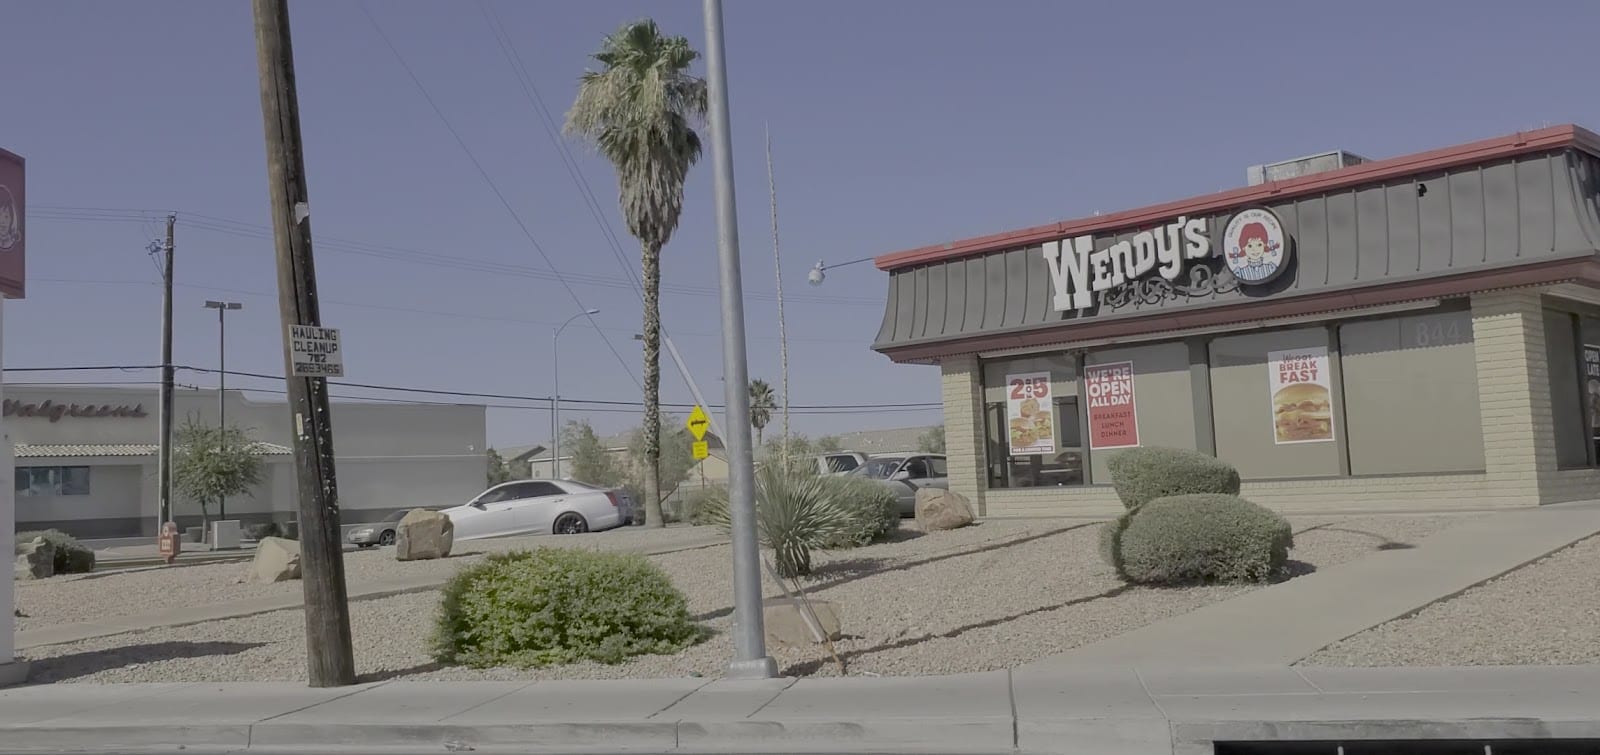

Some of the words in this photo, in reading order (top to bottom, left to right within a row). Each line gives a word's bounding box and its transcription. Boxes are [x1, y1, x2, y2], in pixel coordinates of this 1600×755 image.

[292, 327, 337, 341] HAULING
[293, 341, 338, 354] CLEANUP
[307, 353, 327, 363] 702
[1279, 361, 1317, 371] BREAK
[1088, 367, 1130, 383] WE'RE
[1280, 369, 1318, 383] FAST
[1010, 378, 1025, 400] 2
[1032, 377, 1048, 398] 5
[1089, 379, 1132, 397] OPEN
[1091, 397, 1110, 407] ALL
[1111, 395, 1131, 406] DAY
[1094, 411, 1131, 420] BREAKFAST
[1101, 421, 1125, 429] LUNCH
[1101, 429, 1127, 438] DINNER
